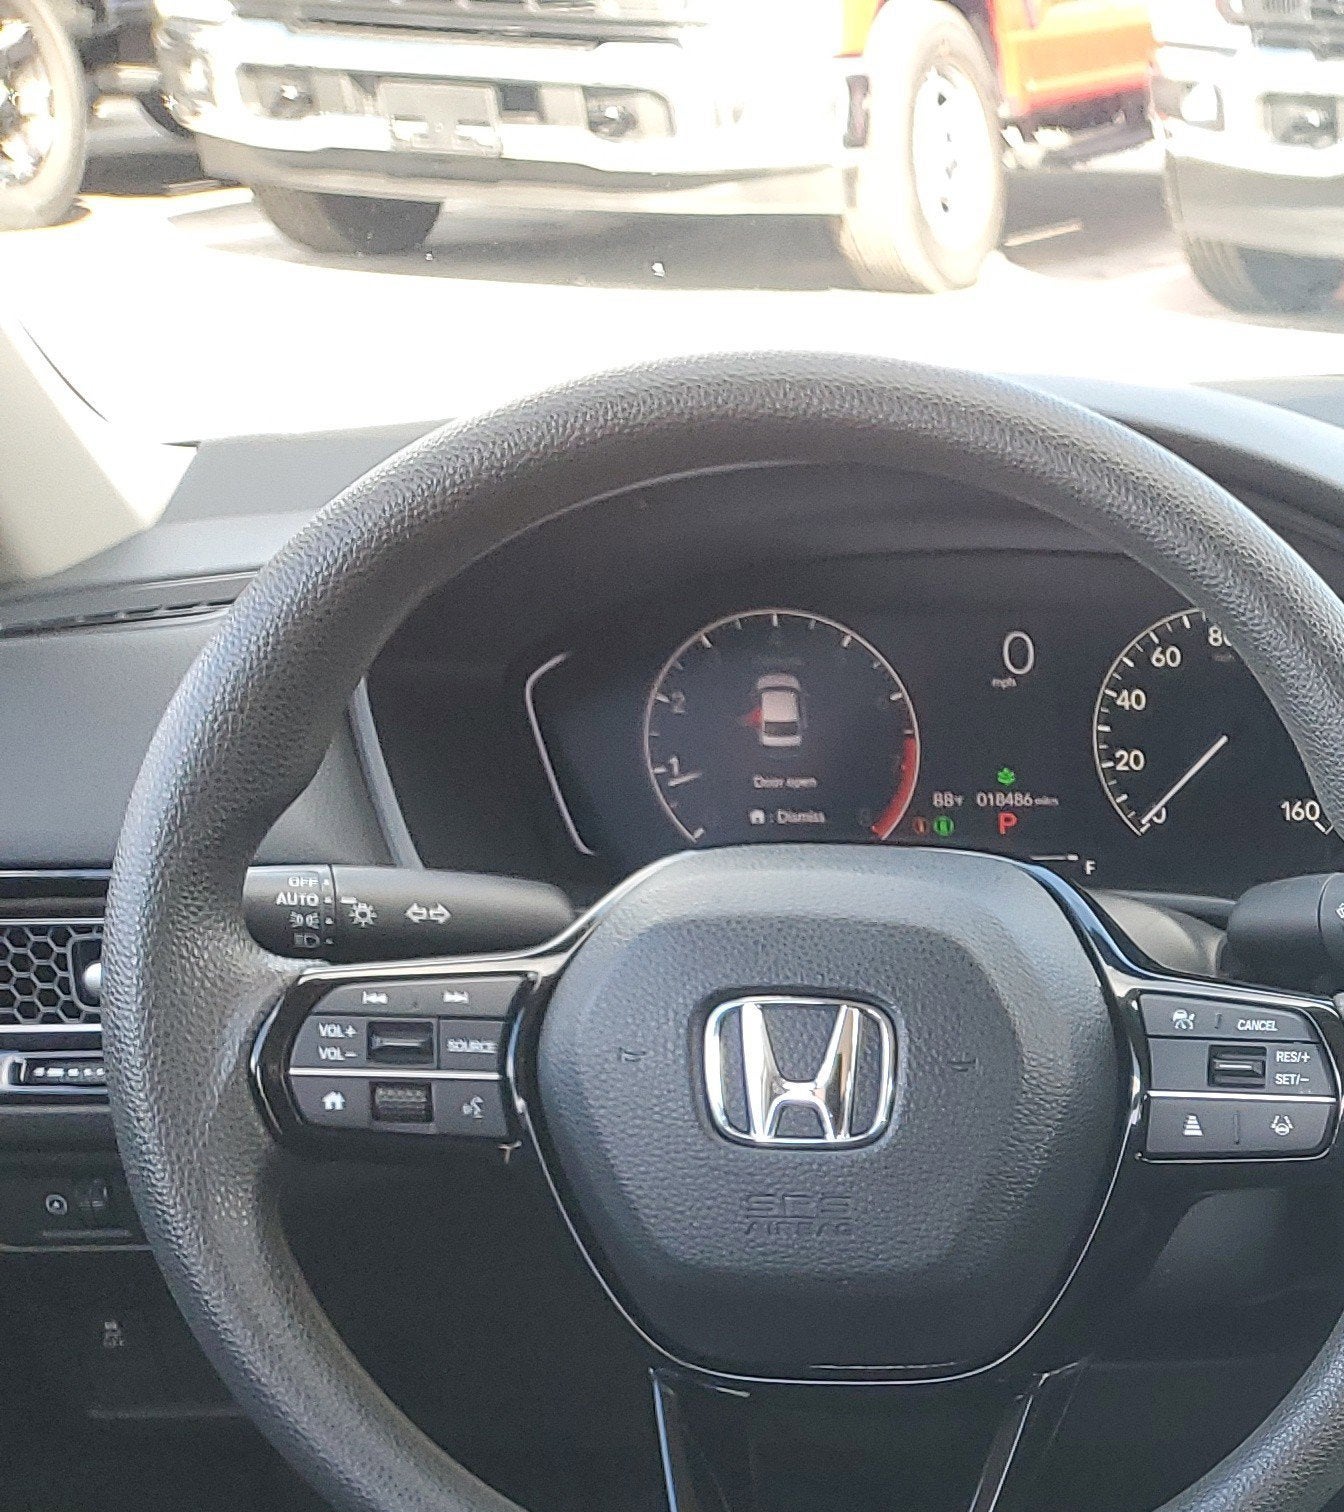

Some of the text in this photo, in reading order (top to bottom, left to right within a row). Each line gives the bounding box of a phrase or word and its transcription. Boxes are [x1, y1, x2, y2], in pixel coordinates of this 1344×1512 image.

[1002, 630, 1035, 675] 0
[1151, 645, 1182, 668] 60
[1115, 688, 1147, 711] 40
[1115, 749, 1146, 771] 20
[1280, 800, 1321, 821] 160
[998, 812, 1018, 836] P
[1084, 859, 1097, 875] F
[276, 891, 319, 907] AUTO
[1237, 1019, 1278, 1032] CANCEL
